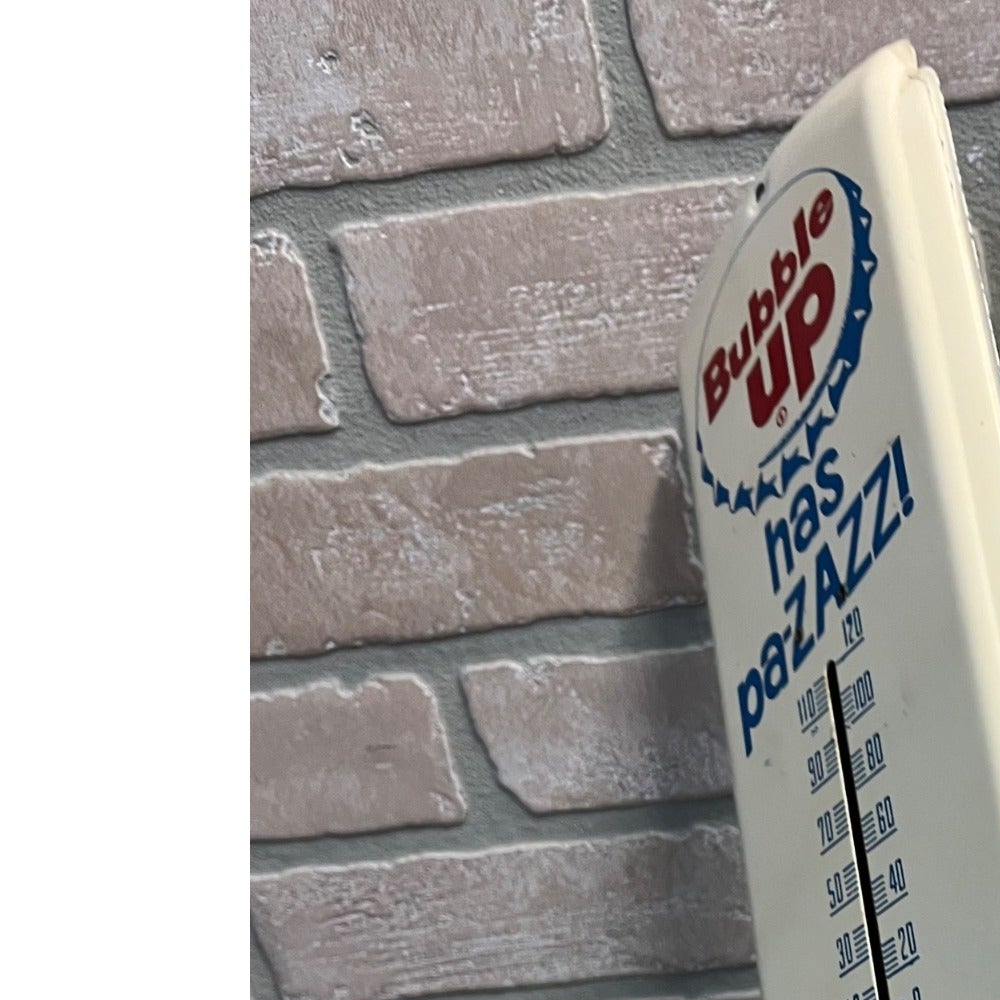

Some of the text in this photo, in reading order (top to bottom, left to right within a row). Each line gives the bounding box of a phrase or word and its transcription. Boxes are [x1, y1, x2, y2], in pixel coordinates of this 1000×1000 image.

[703, 188, 833, 425] Bubble
[842, 606, 863, 647] 120
[797, 688, 816, 725] 110
[852, 670, 875, 711] 100
[807, 750, 824, 787] 90
[865, 732, 884, 771] 80
[816, 810, 834, 847] 70
[875, 795, 896, 834] 60
[826, 872, 844, 909] 50
[889, 858, 906, 893] 40
[836, 932, 853, 969] 30
[897, 921, 918, 961] 20
